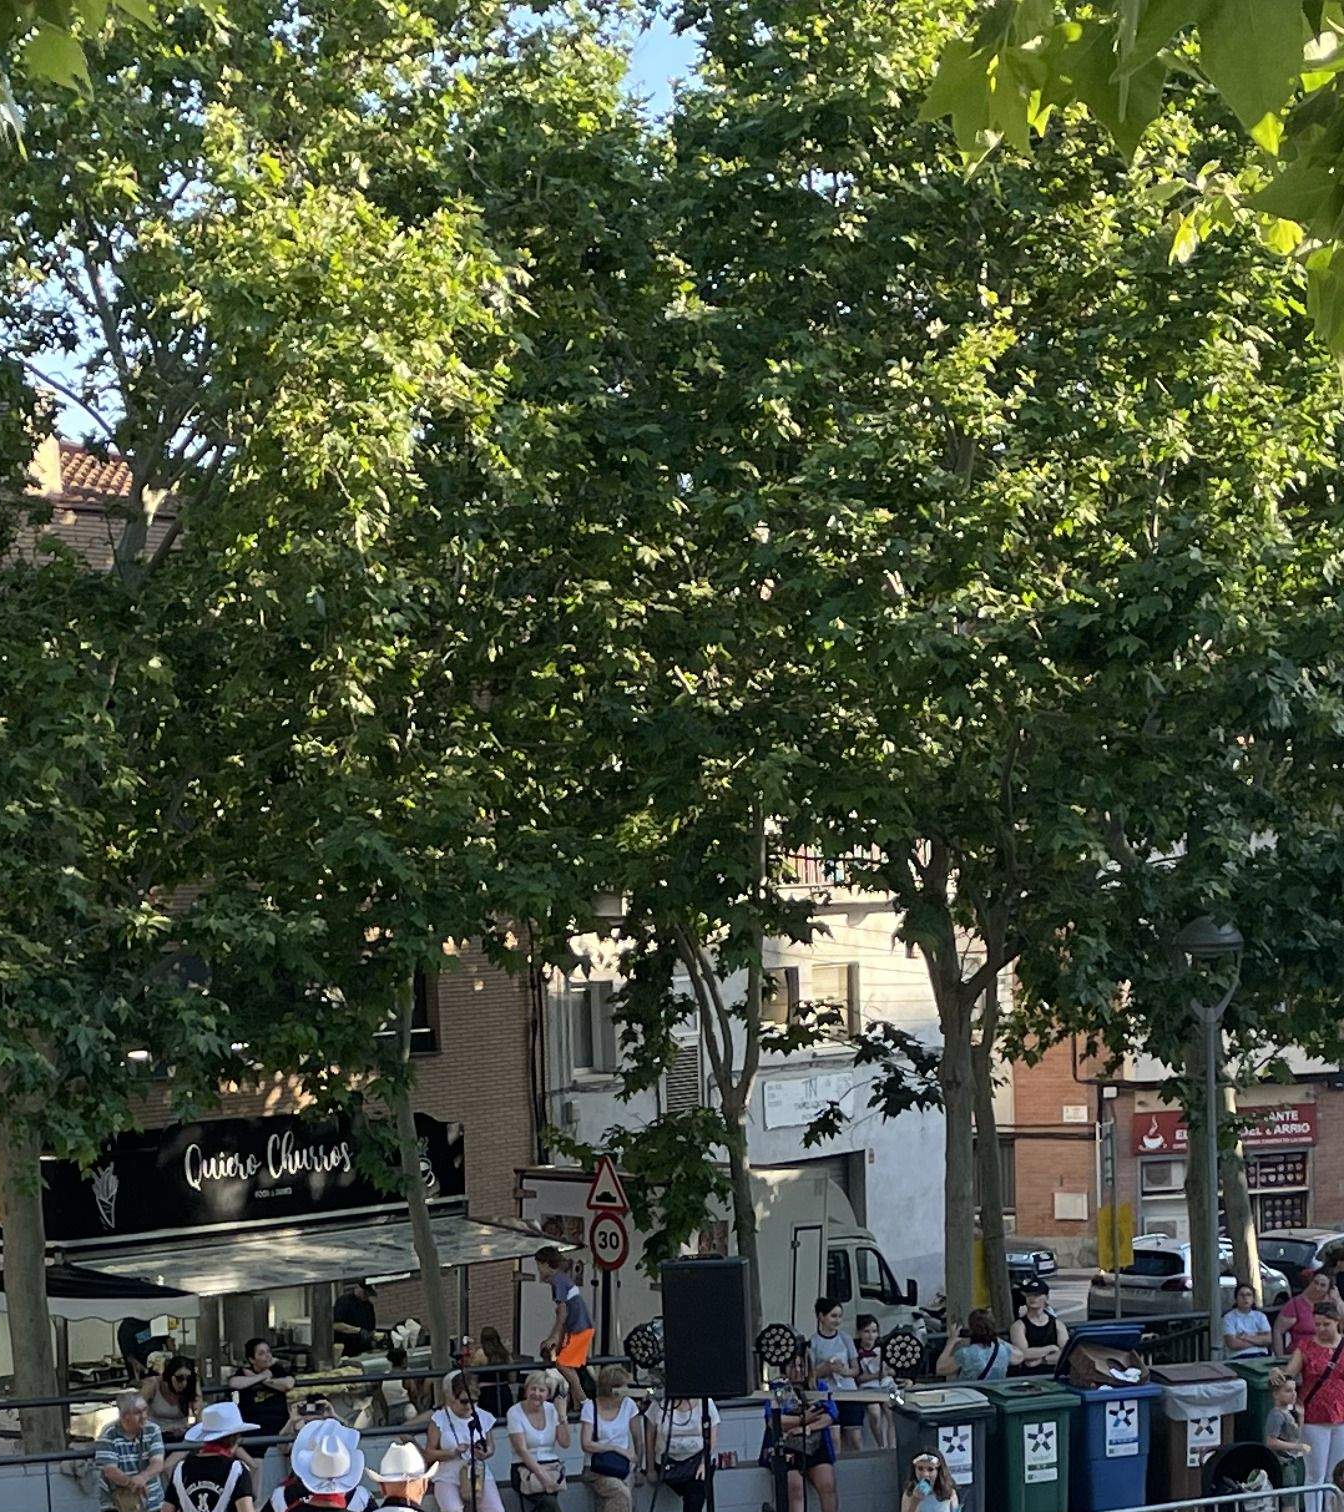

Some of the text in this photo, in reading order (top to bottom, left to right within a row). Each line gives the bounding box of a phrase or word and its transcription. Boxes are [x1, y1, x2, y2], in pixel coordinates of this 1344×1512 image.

[184, 1130, 354, 1191] Quiero Churros
[598, 1230, 620, 1250] 30
